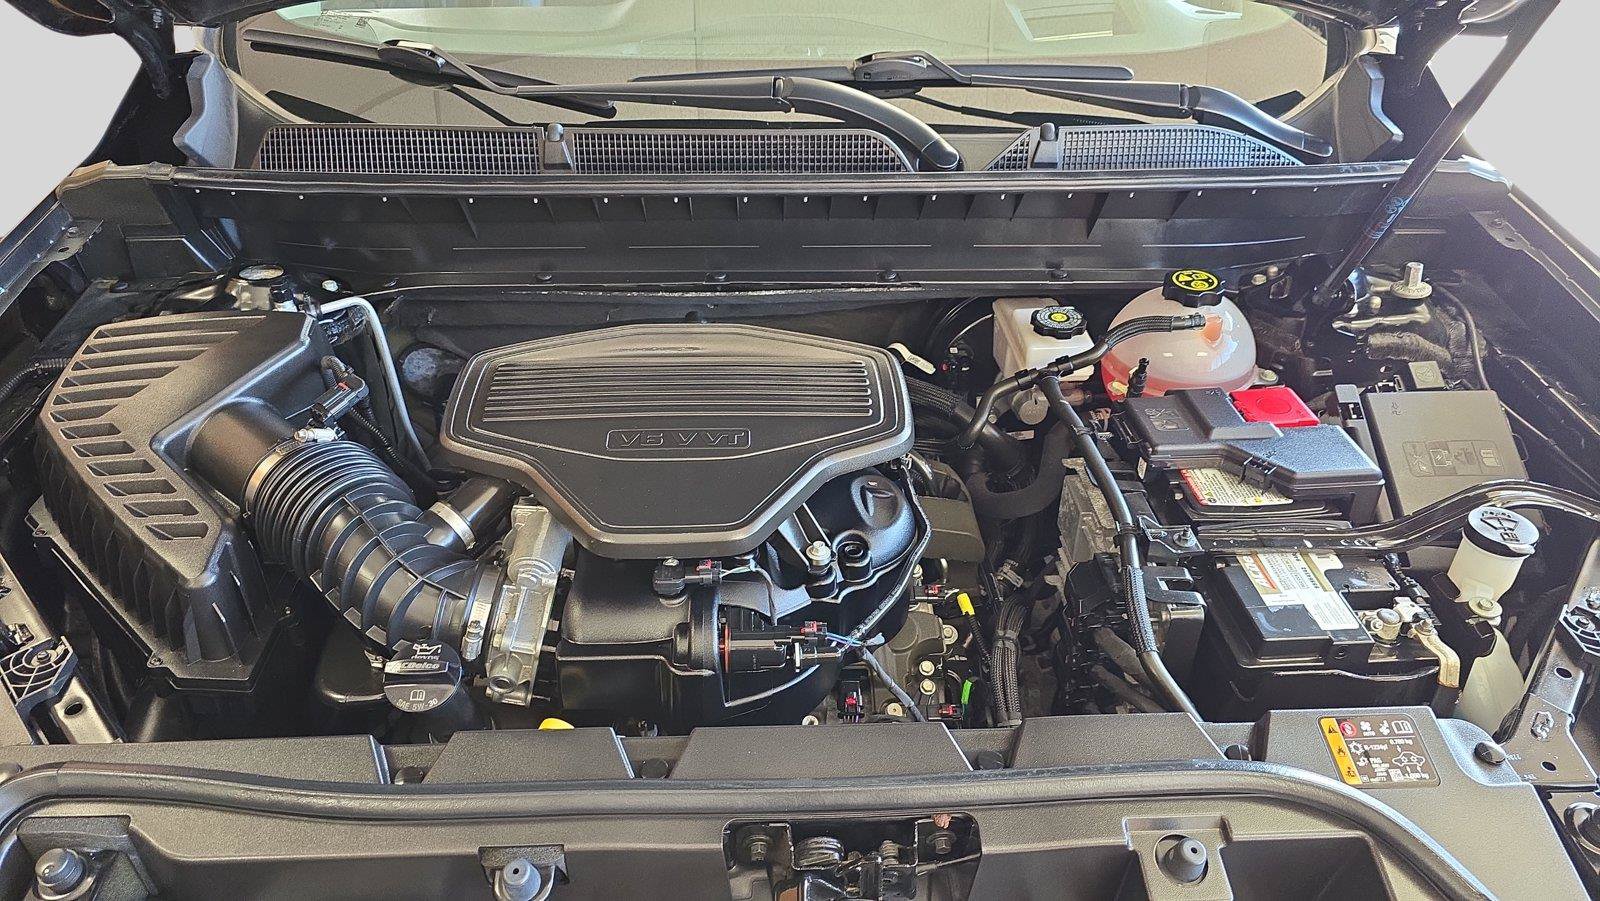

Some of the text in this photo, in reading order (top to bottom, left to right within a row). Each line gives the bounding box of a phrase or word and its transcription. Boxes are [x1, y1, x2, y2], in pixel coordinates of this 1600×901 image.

[620, 432, 664, 447] V6
[396, 698, 438, 710] SAE 5W-30
